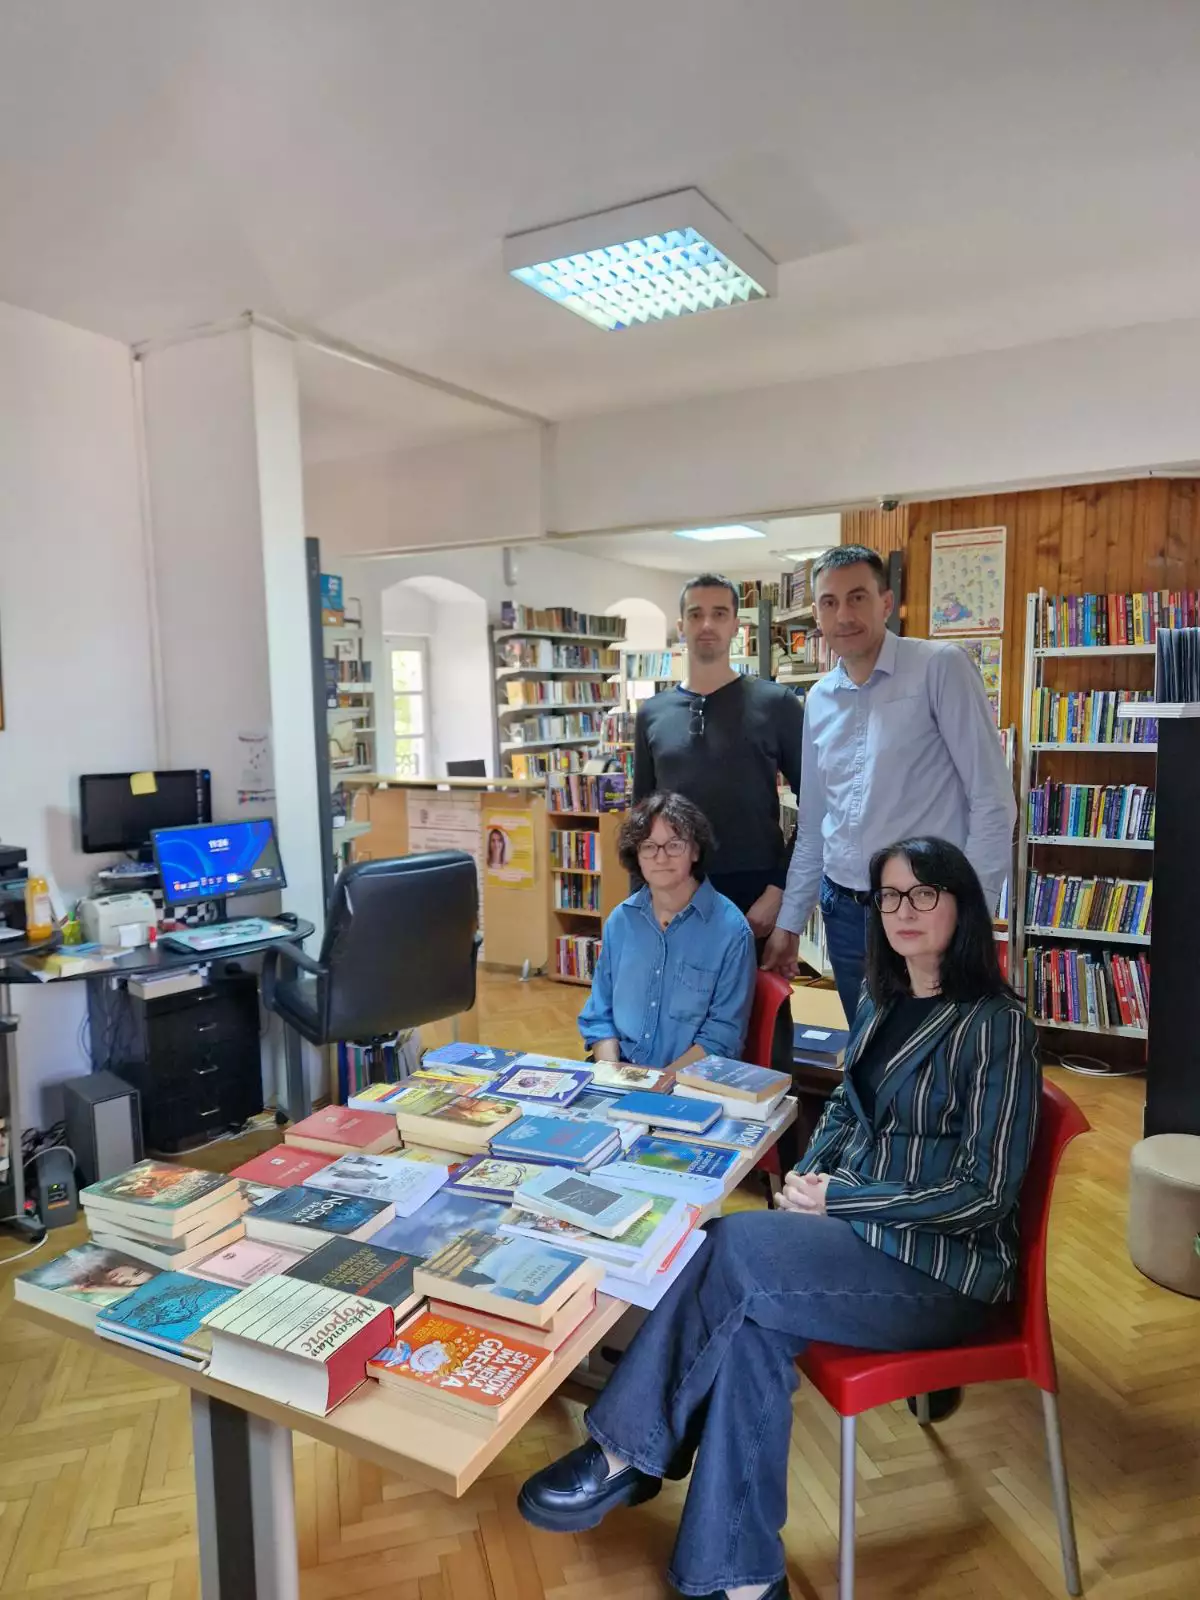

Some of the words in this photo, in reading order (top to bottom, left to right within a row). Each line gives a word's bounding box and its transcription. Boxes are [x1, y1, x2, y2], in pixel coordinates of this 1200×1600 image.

[311, 1302, 377, 1357] Aleksandar
[490, 1348, 516, 1364] IMA
[509, 1351, 530, 1366] SA
[468, 1365, 499, 1388] NEKA
[481, 1365, 517, 1396] MNOM
